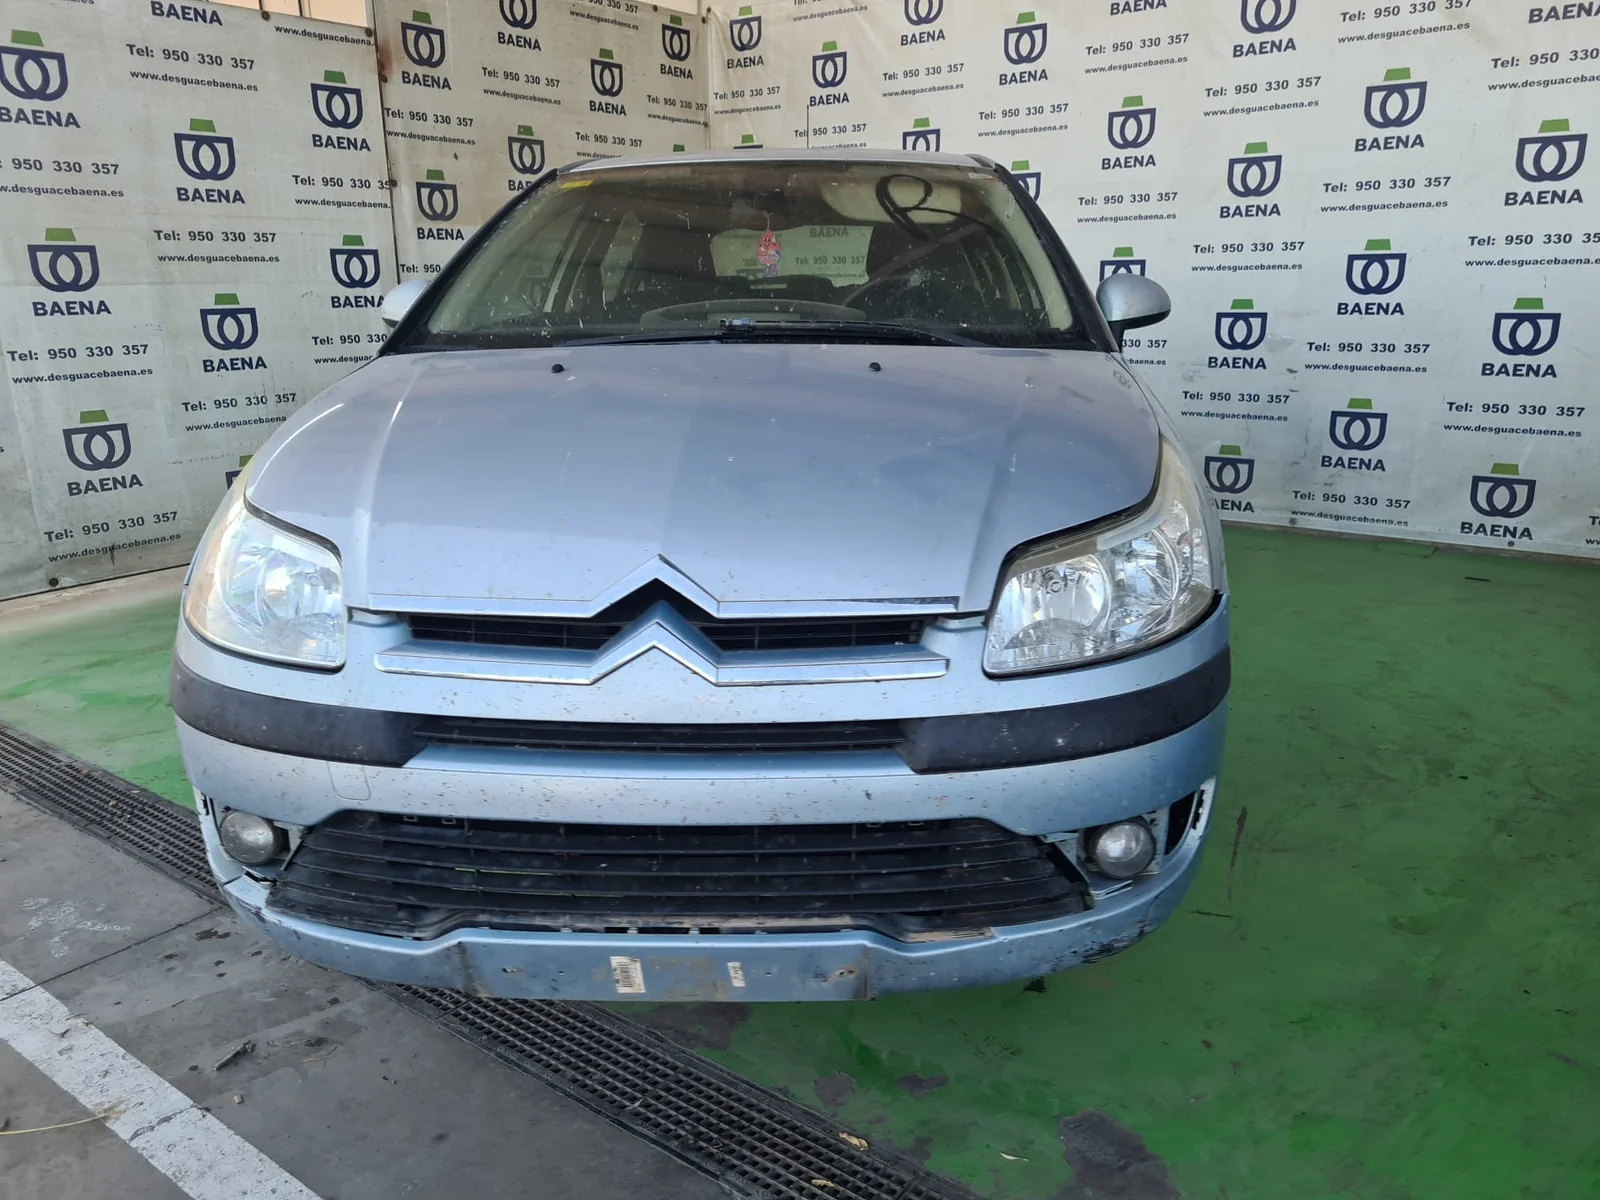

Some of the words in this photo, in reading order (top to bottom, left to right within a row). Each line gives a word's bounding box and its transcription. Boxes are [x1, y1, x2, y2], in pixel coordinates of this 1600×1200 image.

[150, 1, 223, 26] BAENA
[625, 3, 638, 14] 357
[1110, 0, 1168, 16] BAENA
[1340, 10, 1365, 22] Tel:
[1374, 6, 1400, 18] 950
[1409, 1, 1436, 14] 330
[901, 29, 945, 46] BAENA
[1338, 23, 1470, 43] www.desguacebaena.es
[498, 32, 541, 51] BAENA
[1086, 45, 1105, 55] Tel:
[1112, 41, 1133, 52] 950
[1140, 37, 1160, 48] 330
[1168, 33, 1189, 45] 357
[1233, 38, 1296, 58] BAENA
[126, 44, 154, 57] Tel:
[163, 49, 189, 62] 950
[198, 53, 222, 66] 330
[231, 58, 254, 70] 357
[727, 55, 764, 69] BAENA
[1491, 57, 1519, 69] Tel:
[1530, 52, 1559, 65] 950
[1568, 48, 1600, 62] 330
[660, 64, 693, 80] BAENA
[883, 72, 898, 81] Tel:
[903, 69, 919, 78] 950
[925, 66, 941, 76] 330
[947, 63, 964, 73] 357
[1085, 57, 1187, 74] www.desguacebaena.es
[130, 71, 258, 91] www.desguacebaena.es
[402, 71, 451, 90] BAENA
[482, 67, 498, 78] Tel:
[504, 71, 519, 81] 950
[525, 74, 540, 85] 330
[545, 78, 560, 88] 357
[999, 69, 1048, 86] BAENA
[714, 92, 728, 100] Tel:
[731, 90, 745, 99] 950
[750, 88, 763, 97] 330
[767, 86, 780, 95] 357
[882, 84, 963, 97] www.desguacebaena.es
[1205, 87, 1227, 97] Tel:
[1235, 83, 1257, 94] 950
[1265, 80, 1289, 91] 330
[1297, 76, 1321, 88] 357
[647, 95, 660, 104] Tel:
[664, 98, 676, 106] 950
[680, 100, 692, 109] 330
[696, 103, 707, 111] 357
[809, 92, 850, 107] BAENA
[589, 100, 626, 116] BAENA
[979, 111, 996, 120] Tel:
[1002, 108, 1019, 118] 950
[1026, 106, 1044, 116] 330
[1050, 103, 1068, 113] 357
[1204, 101, 1319, 116] www.desguacebaena.es
[0, 106, 81, 128] BAENA
[385, 107, 404, 119] Tel:
[409, 111, 427, 122] 950
[433, 114, 451, 125] 330
[457, 117, 473, 127] 357
[387, 129, 476, 145] www.desguacebaena.es
[813, 127, 827, 136] 950
[832, 125, 847, 134] 330
[852, 123, 866, 132] 357
[978, 125, 1068, 137] www.desguacebaena.es
[312, 134, 371, 151] BAENA
[576, 132, 590, 141] Tel:
[594, 134, 608, 143] 950
[612, 136, 625, 145] 330
[629, 139, 642, 147] 357
[1355, 134, 1424, 152] BAENA
[12, 158, 42, 170] 950
[52, 161, 82, 173] 330
[91, 163, 119, 174] 357
[1102, 155, 1156, 170] BAENA
[292, 175, 315, 186] Tel:
[322, 177, 343, 187] 950
[350, 178, 371, 189] 330
[1323, 182, 1347, 192] Tel:
[1356, 180, 1381, 191] 950
[1389, 178, 1415, 189] 330
[1424, 176, 1451, 187] 357
[176, 187, 245, 204] BAENA
[1078, 197, 1097, 205] Tel:
[1104, 195, 1123, 204] 950
[1130, 193, 1150, 203] 330
[1157, 192, 1178, 202] 357
[1504, 189, 1583, 206] BAENA
[1220, 203, 1281, 218] BAENA
[1321, 201, 1448, 212] www.desguacebaena.es
[1077, 214, 1176, 223] www.desguacebaena.es
[154, 230, 180, 241] Tel:
[188, 231, 213, 241] 950
[221, 232, 245, 242] 330
[253, 232, 276, 242] 357
[417, 227, 463, 240] BAENA
[1468, 236, 1495, 246] Tel:
[1505, 235, 1533, 245] 950
[1543, 233, 1572, 244] 330
[1193, 244, 1214, 253] Tel:
[1222, 243, 1243, 253] 950
[1251, 242, 1273, 252] 330
[1281, 241, 1305, 251] 357
[158, 254, 279, 263] www.desguacebaena.es
[832, 256, 847, 265] 330
[400, 264, 418, 273] Tel:
[424, 265, 441, 273] 950
[1192, 263, 1302, 272] www.desguacebaena.es
[32, 300, 112, 316] BAENA
[1337, 302, 1404, 315] BAENA
[312, 336, 334, 346] Tel:
[340, 334, 360, 344] 950
[1147, 339, 1167, 348] 357
[1307, 342, 1330, 351] Tel:
[1338, 343, 1362, 352] 950
[1371, 343, 1395, 353] 330
[1404, 344, 1430, 353] 357
[7, 350, 38, 361] Tel:
[48, 348, 76, 359] 950
[86, 346, 113, 357] 330
[122, 344, 148, 355] 357
[203, 356, 267, 372] BAENA
[1208, 357, 1266, 369] BAENA
[1305, 363, 1427, 372] www.desguacebaena.es
[1481, 363, 1557, 378] BAENA
[12, 369, 153, 383] www.desguacebaena.es
[181, 401, 206, 412] Tel:
[214, 398, 237, 409] 950
[245, 395, 268, 406] 330
[275, 393, 296, 403] 357
[1182, 391, 1203, 400] Tel:
[1210, 392, 1231, 401] 950
[1238, 393, 1260, 402] 330
[1267, 395, 1290, 404] 357
[1181, 411, 1287, 421] www.desguacebaena.es
[1447, 402, 1473, 412] Tel:
[1482, 403, 1509, 414] 950
[1518, 405, 1546, 415] 330
[1556, 407, 1585, 417] 357
[1444, 425, 1581, 437] www.desguacebaena.es
[1321, 455, 1385, 471] BAENA
[67, 474, 143, 496] BAENA
[1293, 491, 1314, 500] Tel:
[1323, 493, 1346, 503] 950
[1354, 496, 1377, 506] 330
[1386, 499, 1410, 509] 357
[44, 529, 73, 542] Tel:
[82, 522, 109, 535] 950
[118, 517, 144, 529] 330
[153, 511, 177, 524] 357
[1291, 510, 1409, 527] www.desguacebaena.es
[1460, 522, 1533, 540] BAENA
[48, 534, 181, 563] www.desguacebaena.es
